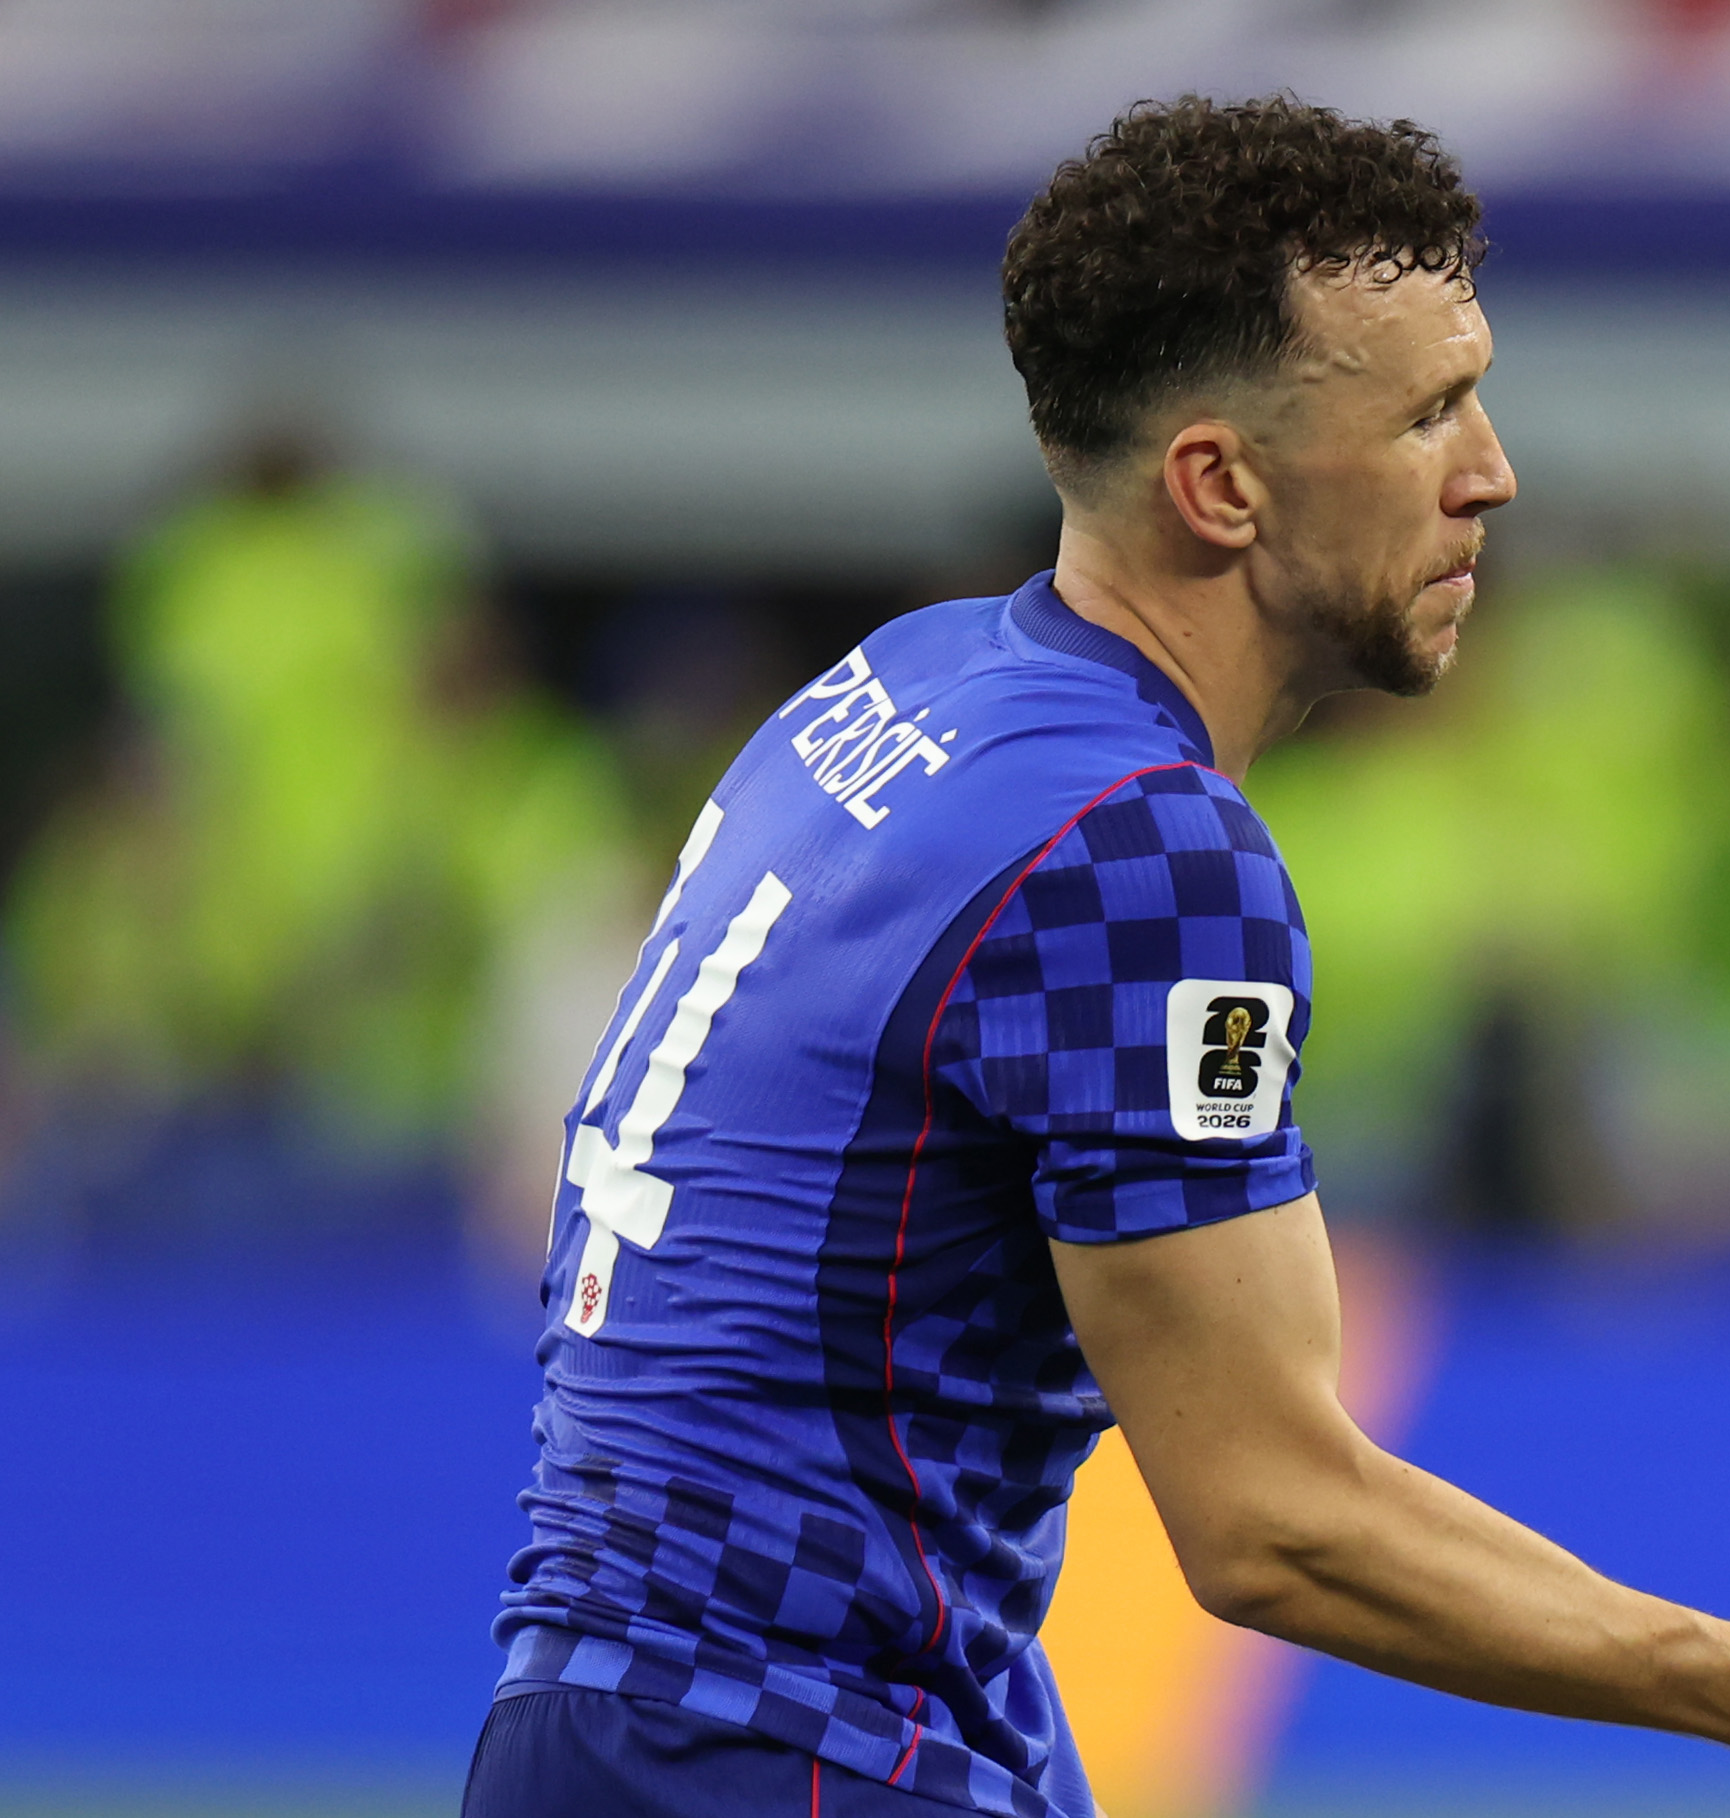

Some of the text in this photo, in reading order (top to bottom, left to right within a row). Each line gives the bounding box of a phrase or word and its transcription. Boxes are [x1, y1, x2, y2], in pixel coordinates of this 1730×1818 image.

[1213, 1077, 1243, 1091] FIFA
[1196, 1103, 1255, 1112] WORLD CUP
[1197, 1114, 1252, 1128] 2026
